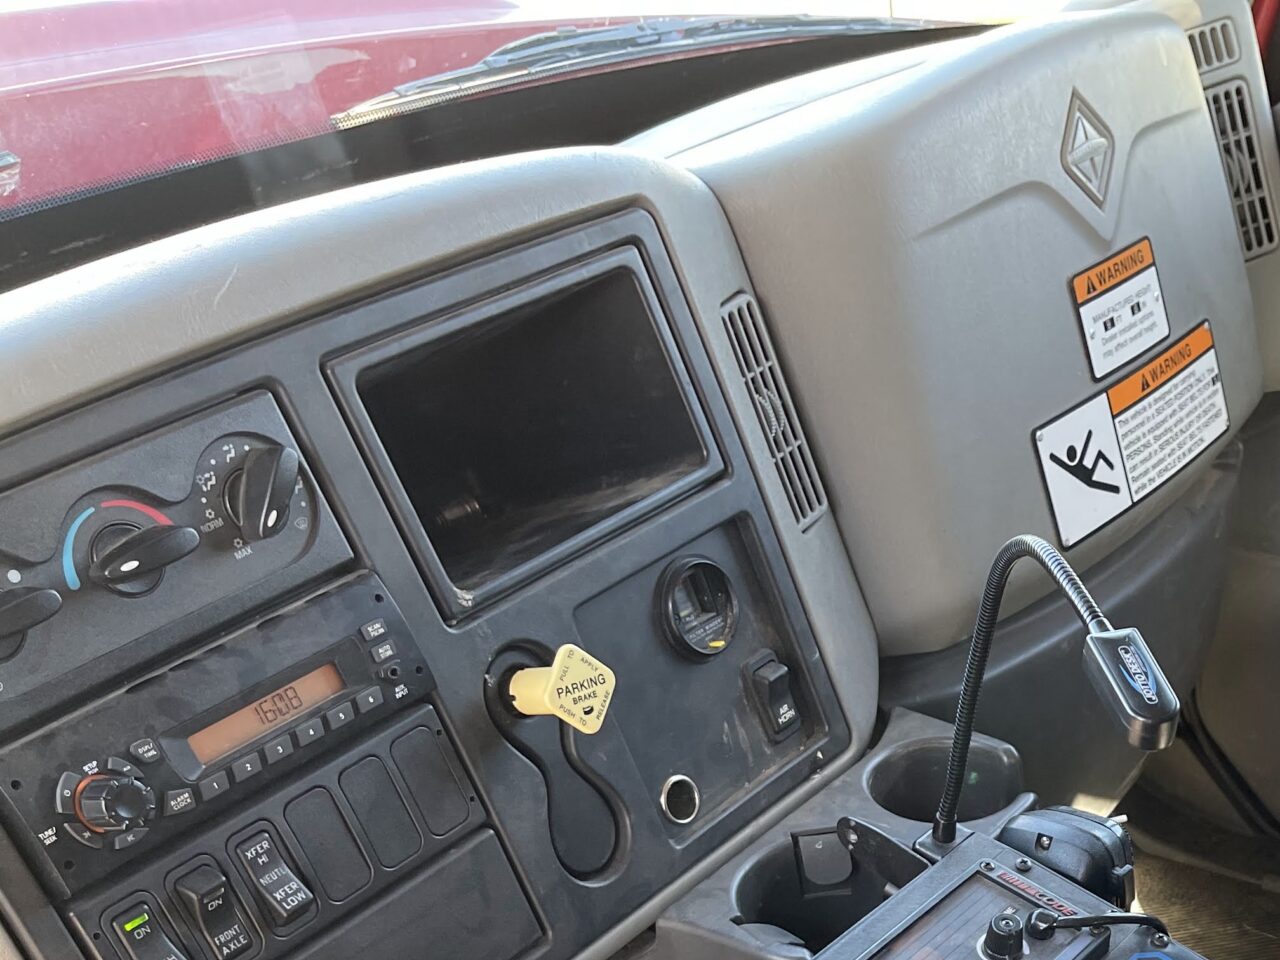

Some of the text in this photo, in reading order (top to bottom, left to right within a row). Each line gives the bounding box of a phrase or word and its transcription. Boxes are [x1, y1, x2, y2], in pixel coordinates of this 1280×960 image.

[1096, 249, 1144, 286] WARNING
[1149, 344, 1192, 382] WARNING
[234, 546, 252, 560] MAX
[568, 650, 574, 658] TO
[581, 658, 598, 672] APPLY
[560, 666, 569, 681] PULL
[556, 674, 606, 698] PARKING
[572, 690, 598, 705] BRAKE
[339, 712, 344, 720] 5
[559, 704, 587, 726] PUSH TO
[778, 708, 795, 725] HORN
[779, 704, 790, 715] AIR
[277, 746, 283, 754] 3
[82, 760, 98, 772] SETUP
[246, 763, 252, 771] 2
[170, 792, 190, 806] ALARM
[173, 798, 192, 810] CLOCK
[38, 826, 56, 840] TUNE/
[43, 835, 58, 846] SEEK
[245, 840, 270, 859] XFER
[258, 854, 269, 866] HI
[273, 881, 300, 901] XFER
[207, 898, 223, 910] ON
[282, 891, 306, 910] LOW
[133, 925, 152, 940] ON
[214, 924, 241, 946] FRONT
[222, 935, 248, 956] AXLE
